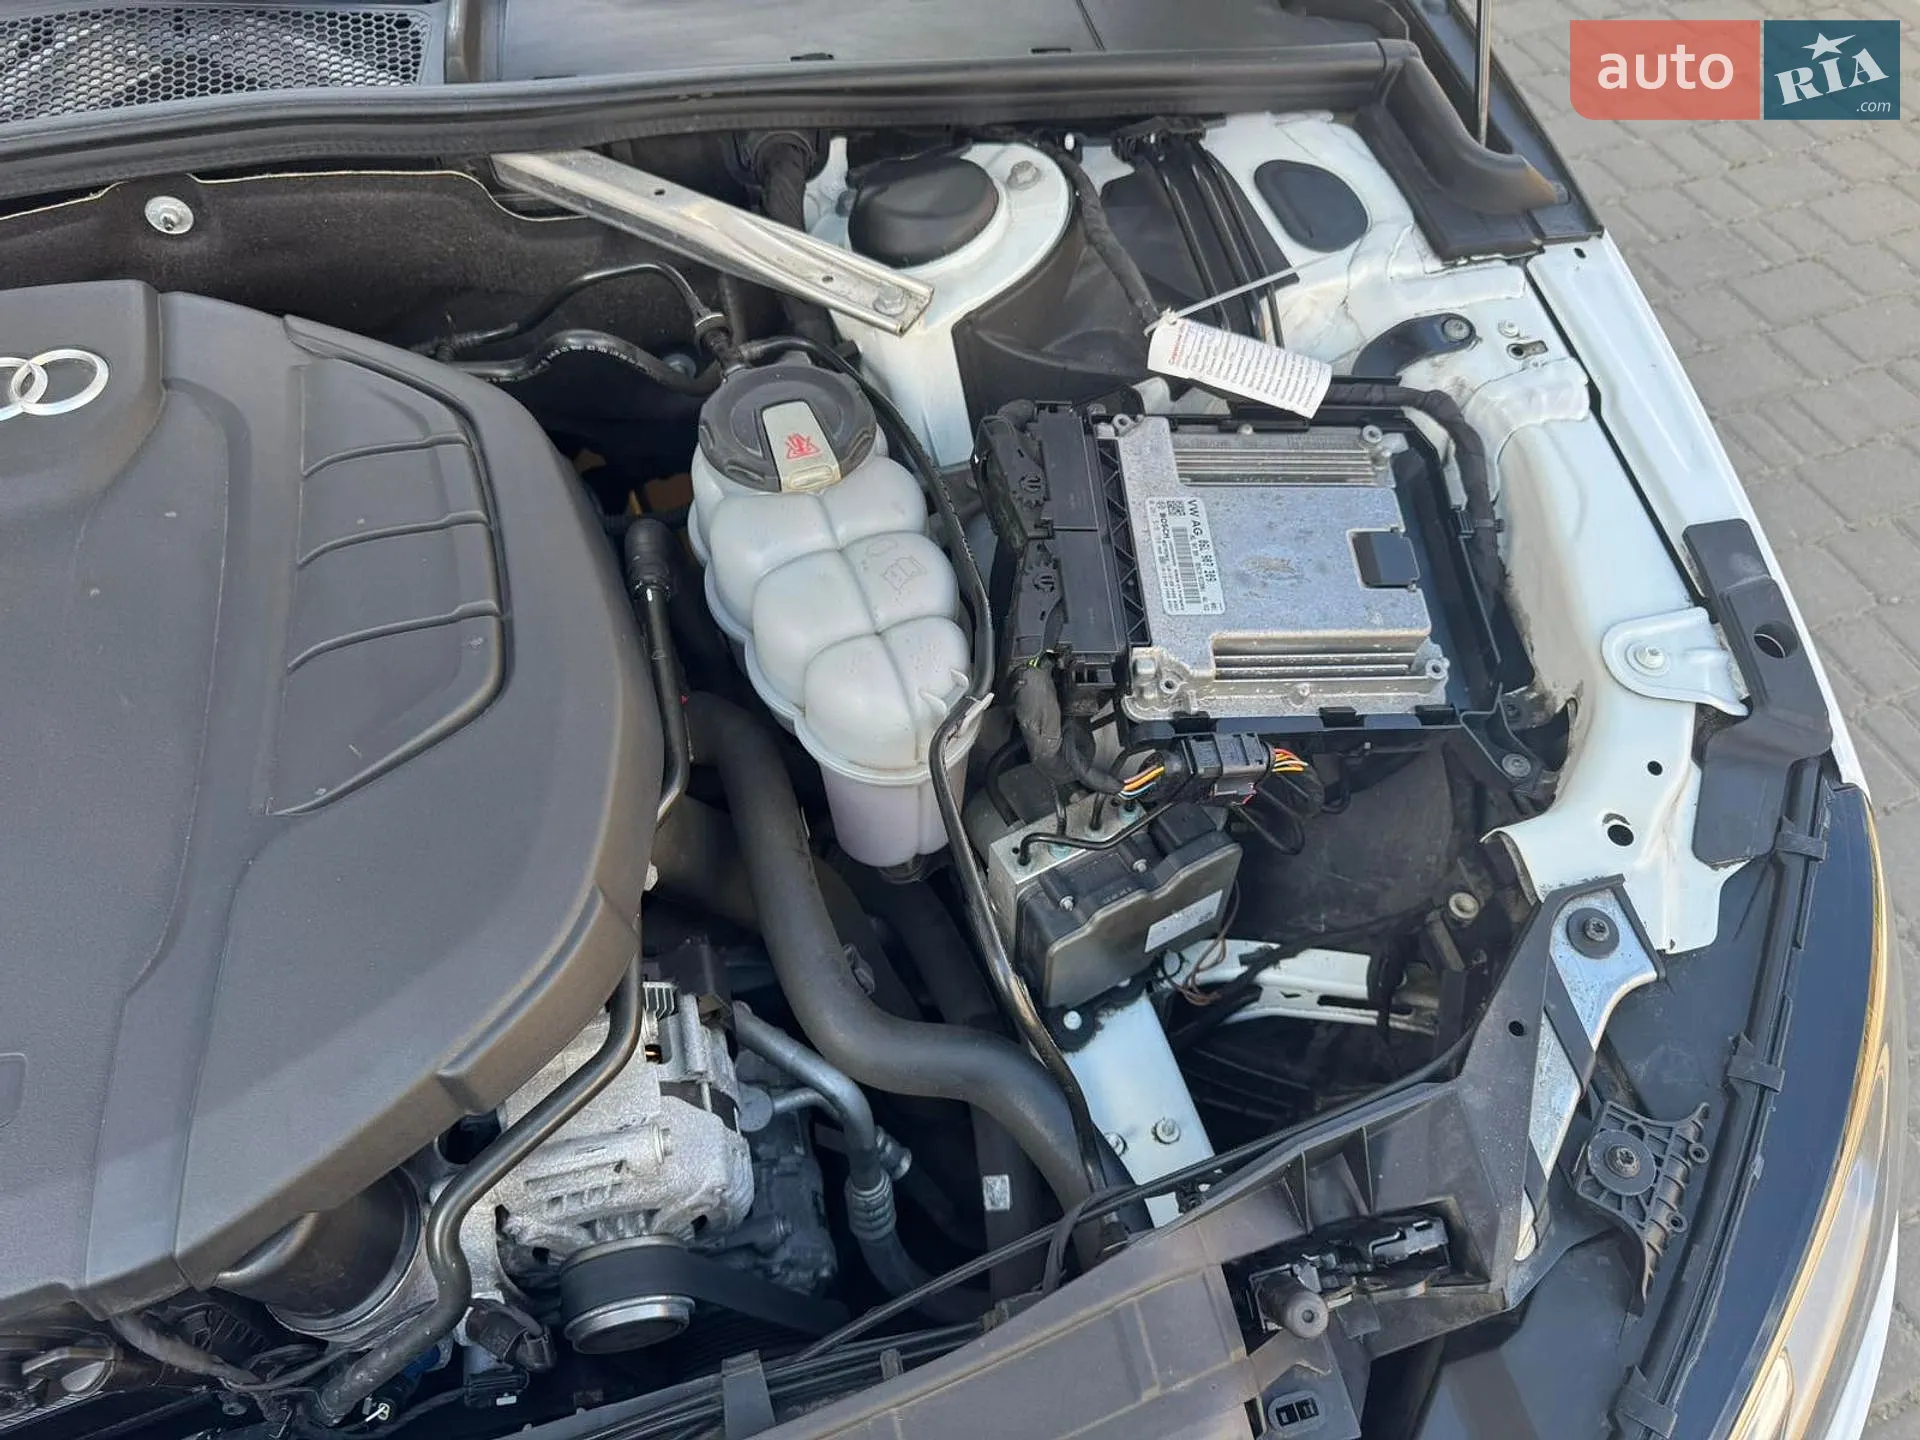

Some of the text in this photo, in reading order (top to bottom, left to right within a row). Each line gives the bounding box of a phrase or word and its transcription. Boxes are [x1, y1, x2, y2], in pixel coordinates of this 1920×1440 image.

[1188, 499, 1199, 517] VW
[1160, 512, 1170, 539] BOSCH
[1191, 520, 1203, 536] AG
